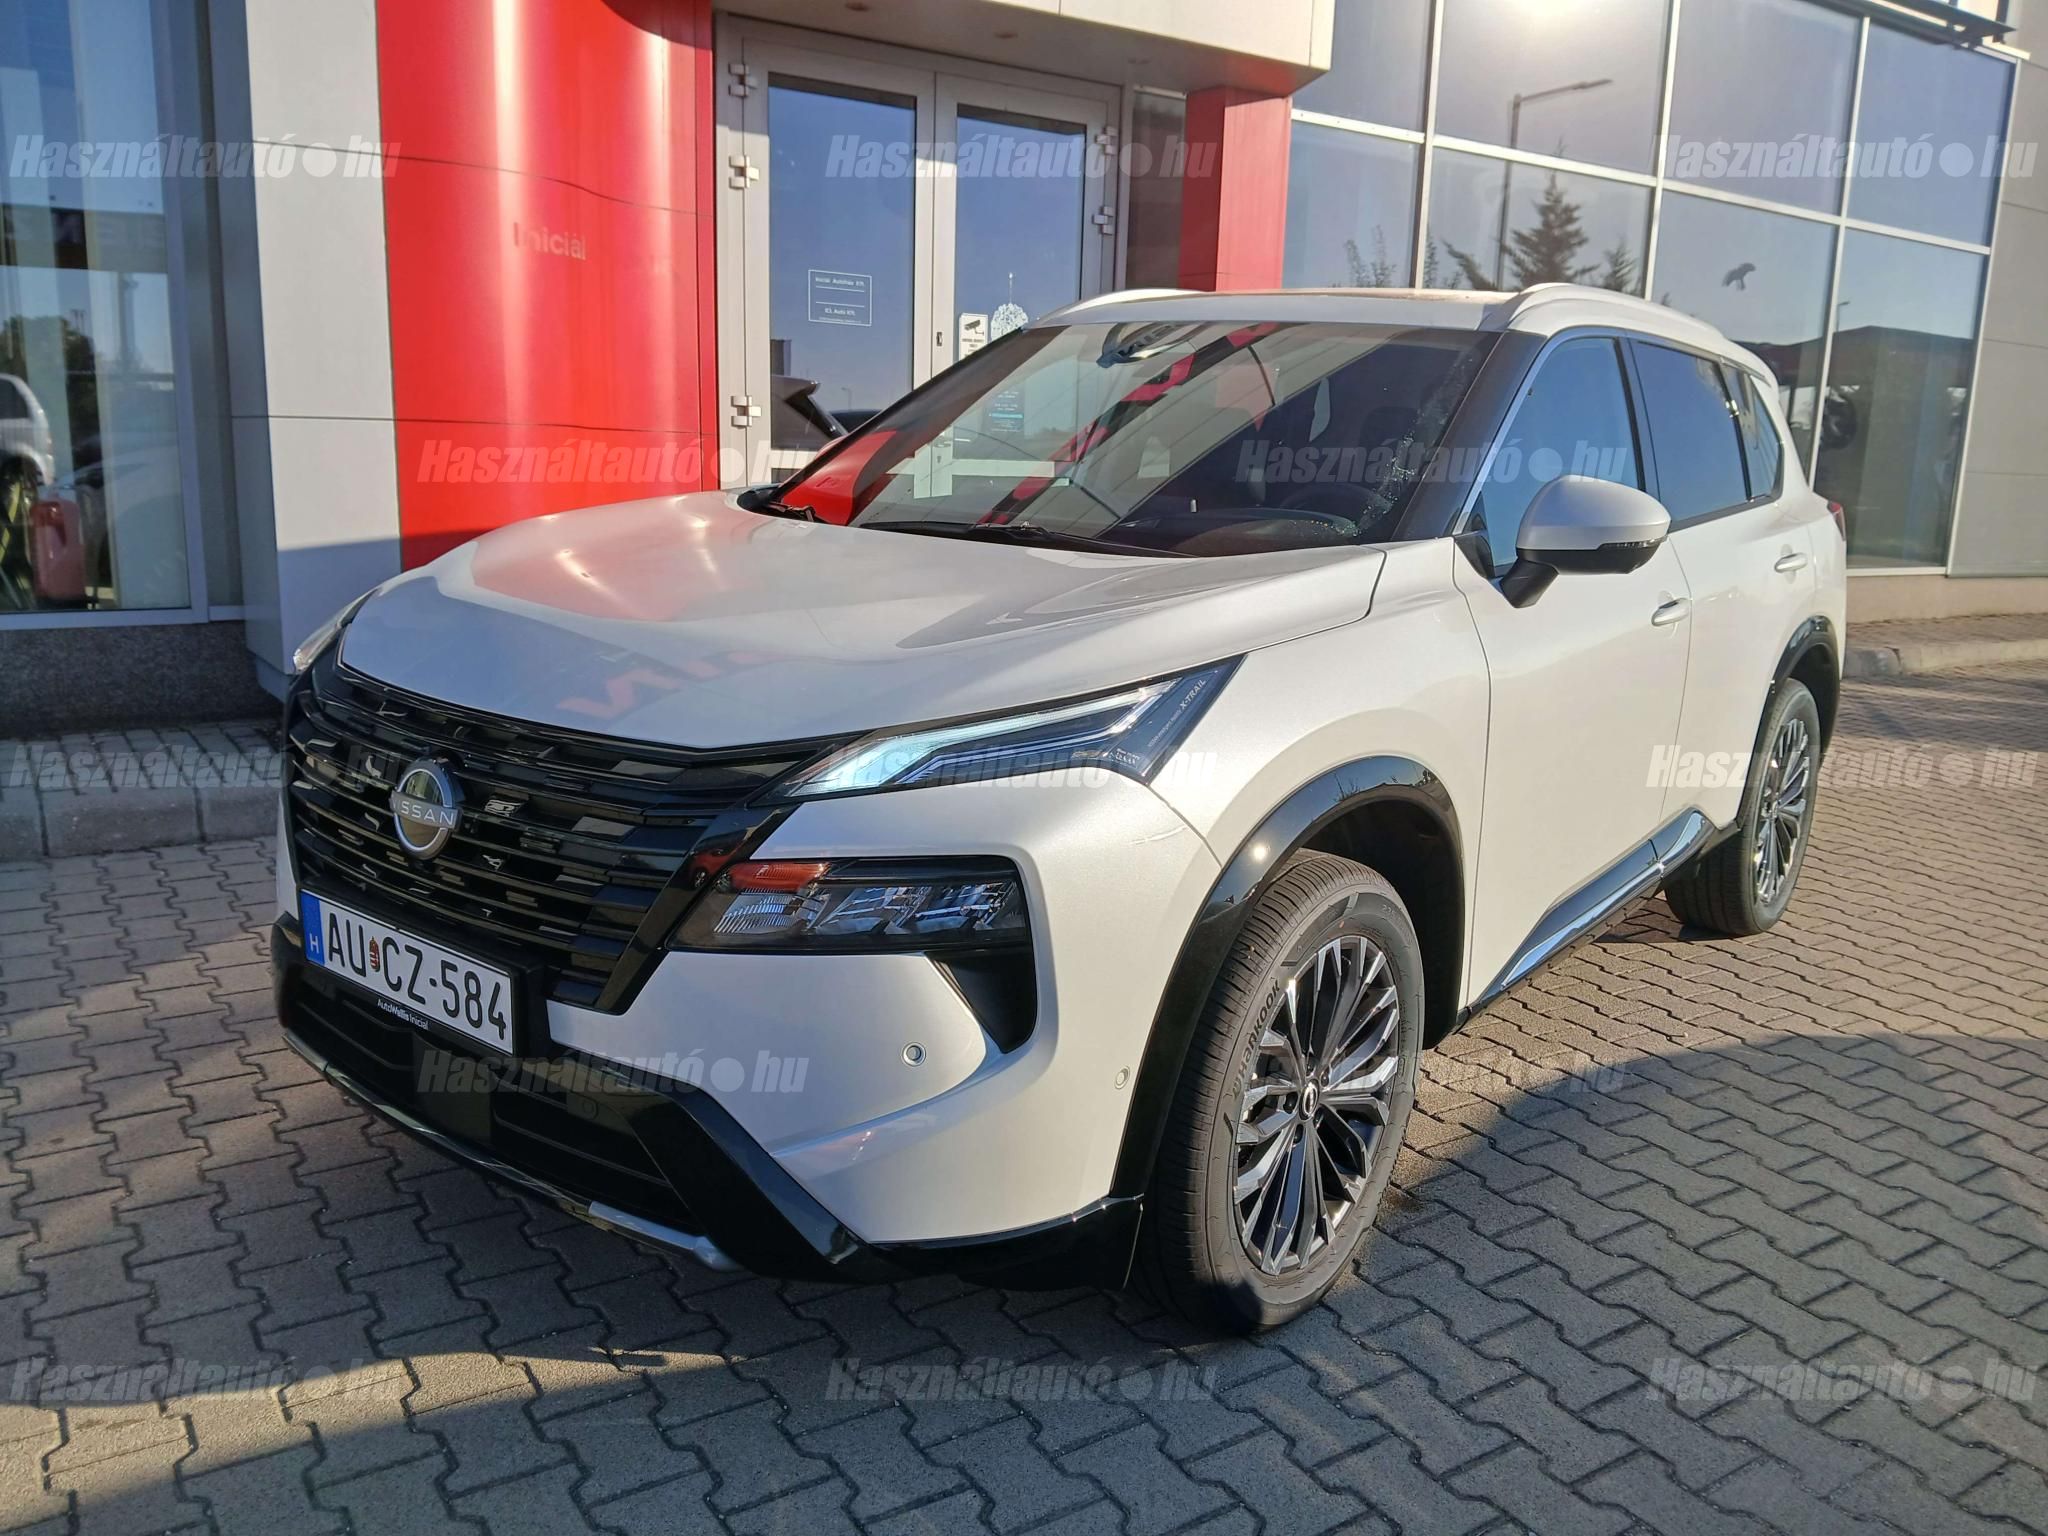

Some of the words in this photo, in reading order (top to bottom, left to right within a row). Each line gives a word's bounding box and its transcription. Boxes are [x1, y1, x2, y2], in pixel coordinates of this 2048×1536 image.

[1180, 679, 1206, 710] X-TRAIL
[309, 933, 319, 953] H
[328, 912, 367, 977] AU
[382, 936, 507, 1040] CZ-584
